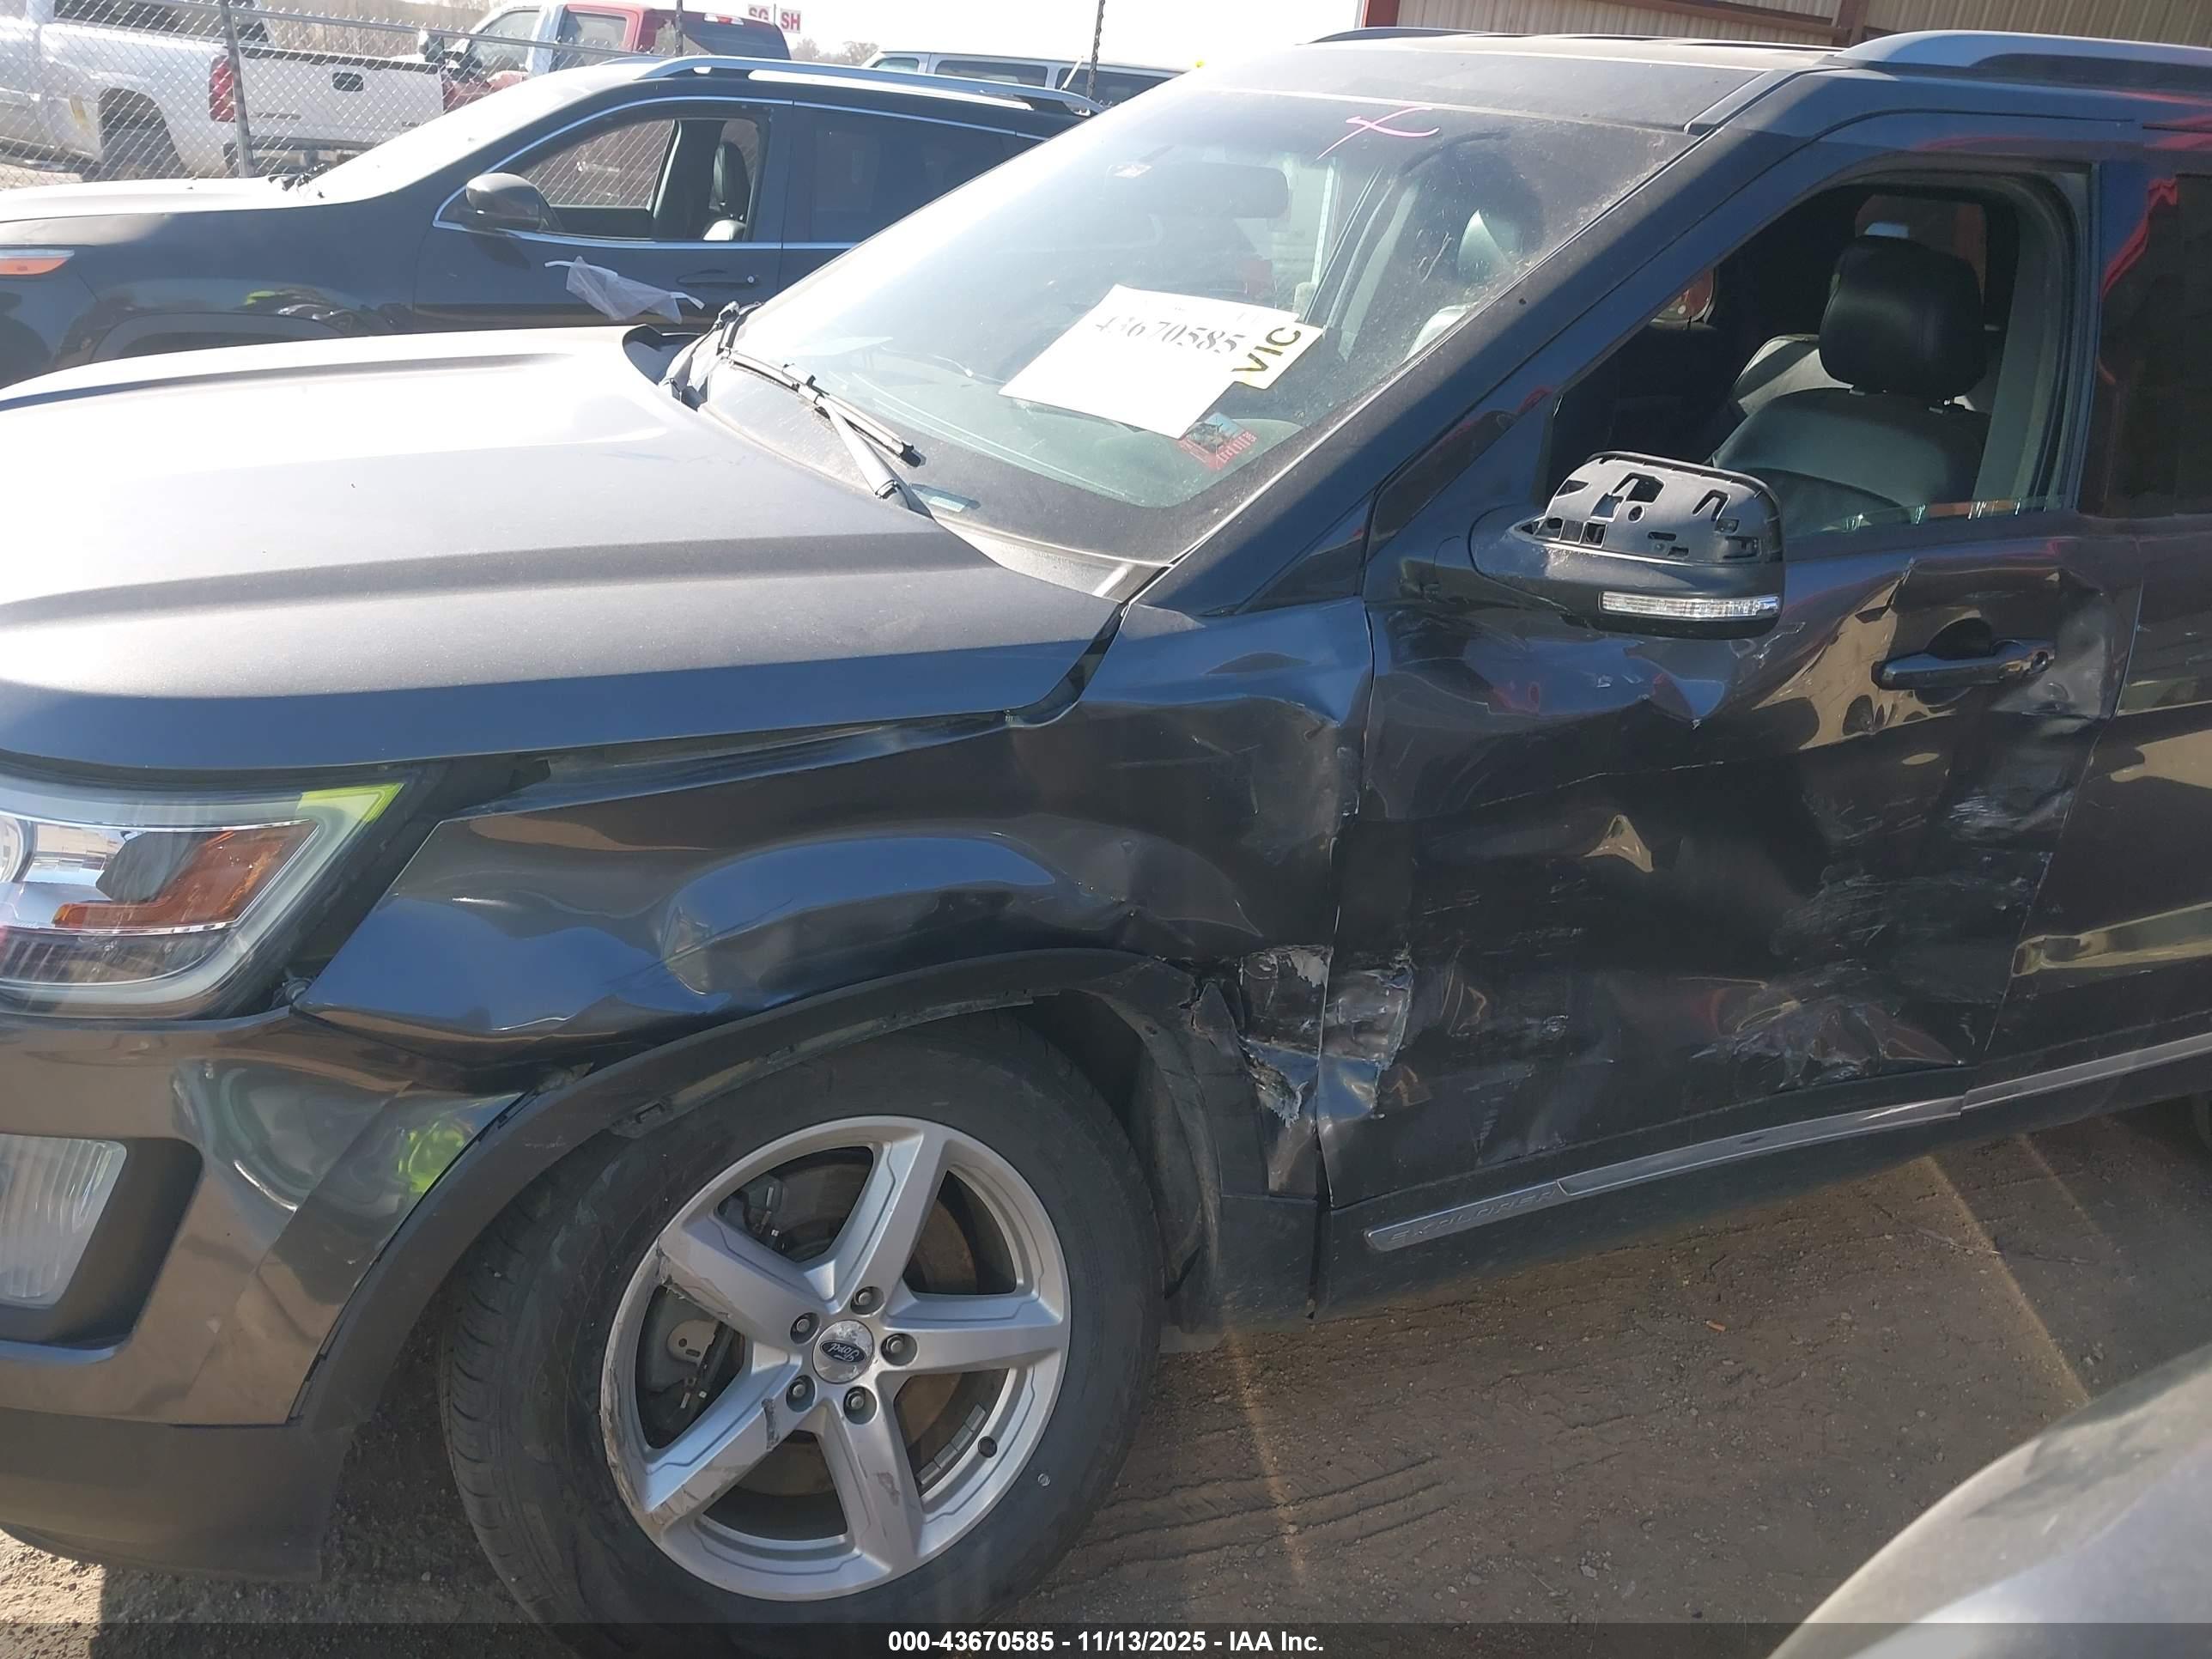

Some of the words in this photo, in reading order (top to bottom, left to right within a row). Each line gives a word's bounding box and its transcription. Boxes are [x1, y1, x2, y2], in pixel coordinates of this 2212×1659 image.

[781, 11, 800, 31] SH
[1231, 326, 1302, 373] VIC
[826, 1341, 861, 1362] Ford
